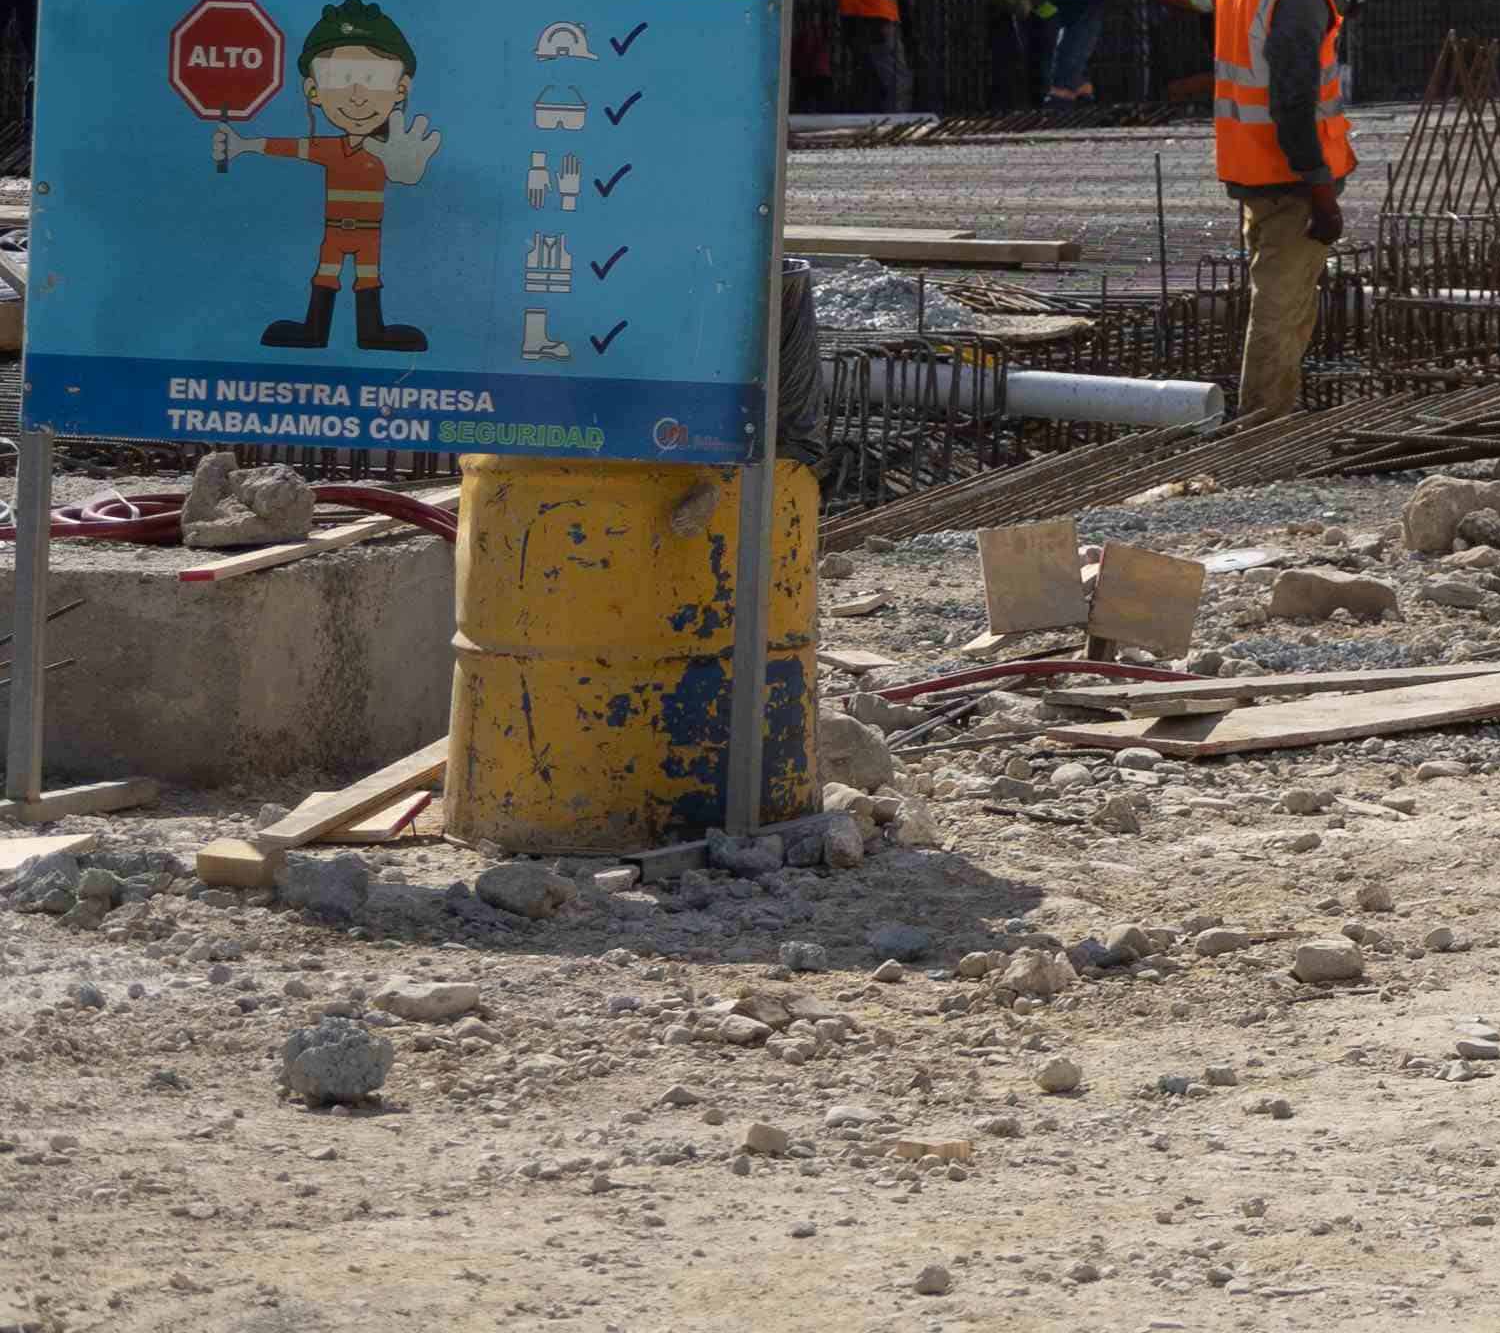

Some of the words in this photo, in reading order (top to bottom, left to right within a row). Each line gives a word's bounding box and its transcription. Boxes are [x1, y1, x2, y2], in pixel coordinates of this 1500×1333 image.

[187, 46, 264, 69] ALTO
[169, 378, 206, 403] EN
[216, 381, 351, 408] NUESTRA
[359, 385, 495, 413] EMPRESA
[168, 409, 360, 439] TRABAJAMOS
[369, 416, 430, 442] CON
[438, 420, 604, 450] SEGURIDAD
